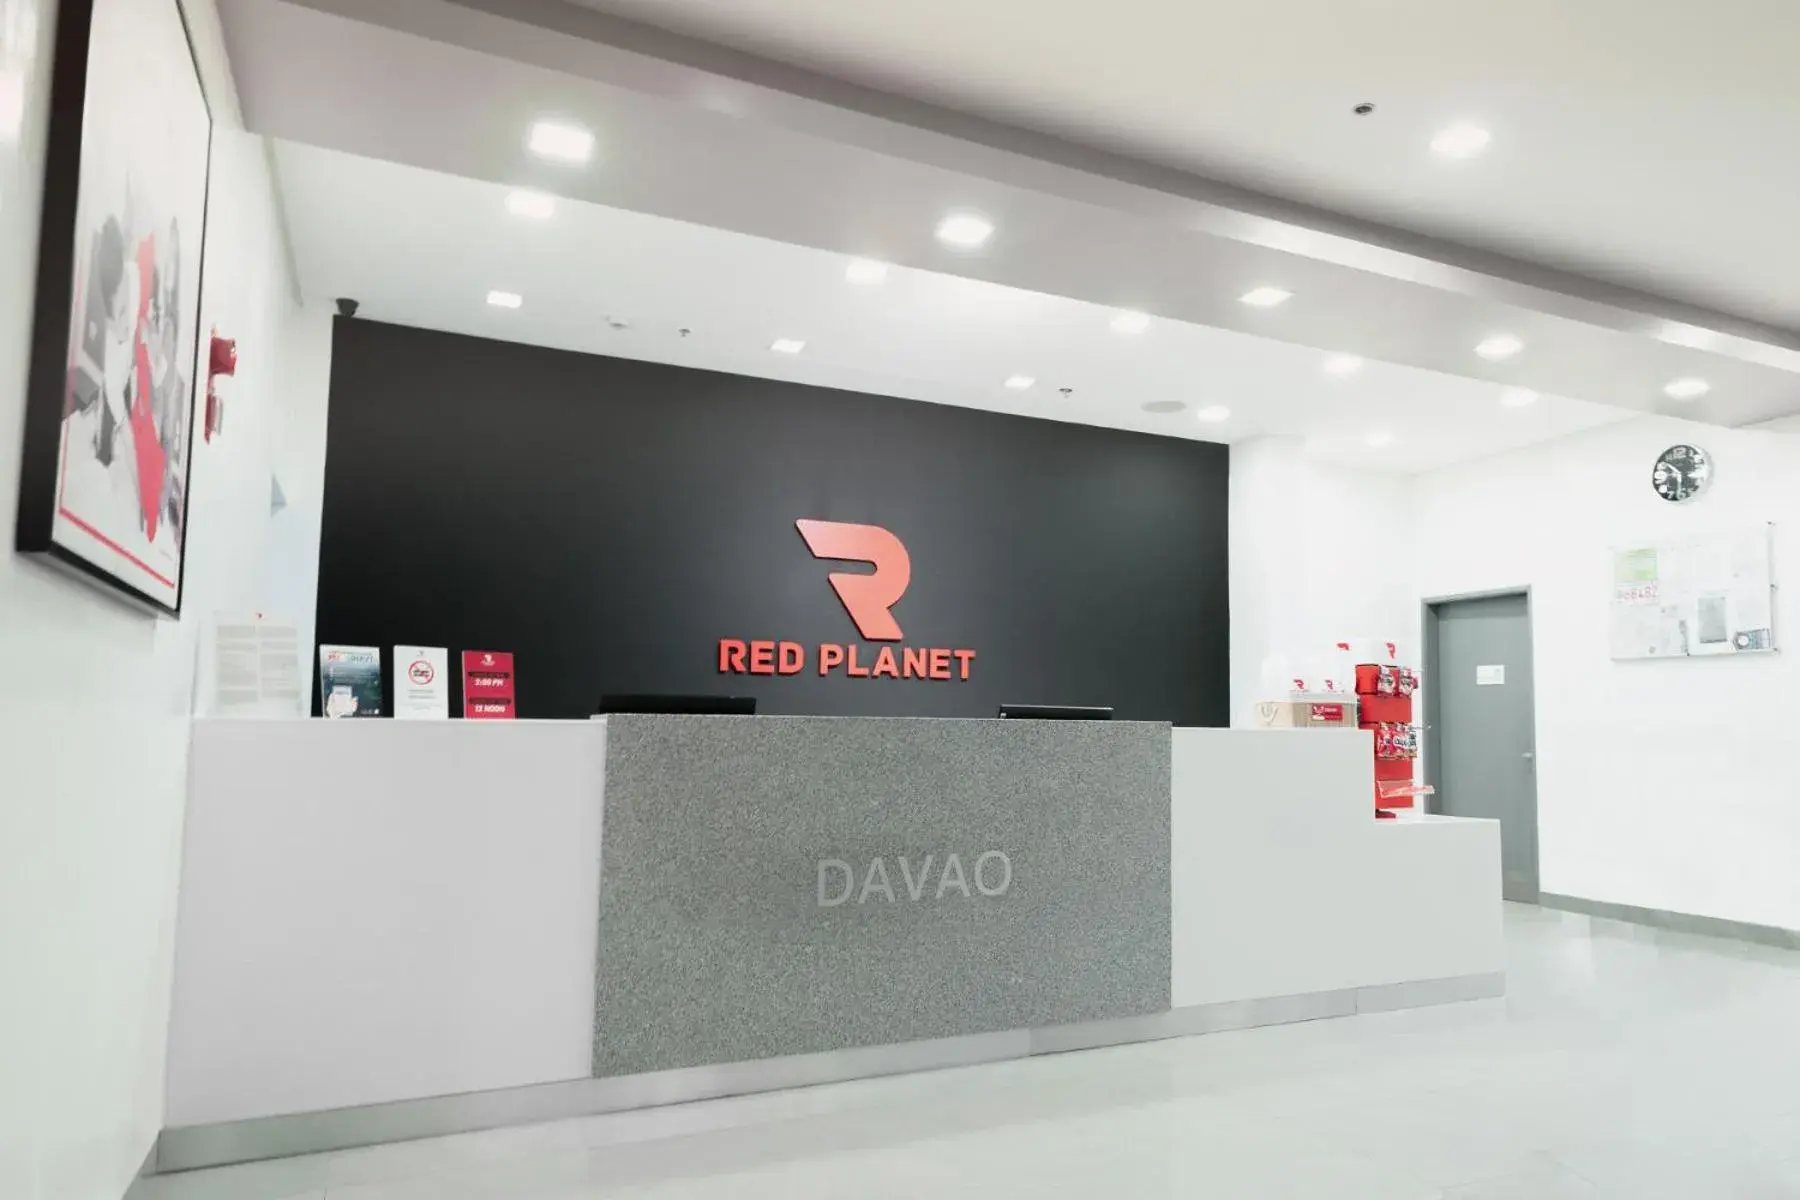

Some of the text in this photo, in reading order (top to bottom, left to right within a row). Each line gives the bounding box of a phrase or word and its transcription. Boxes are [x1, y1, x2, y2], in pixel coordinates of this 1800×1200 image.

[717, 638, 977, 681] RED PLANET
[817, 850, 1013, 908] DAVAO
